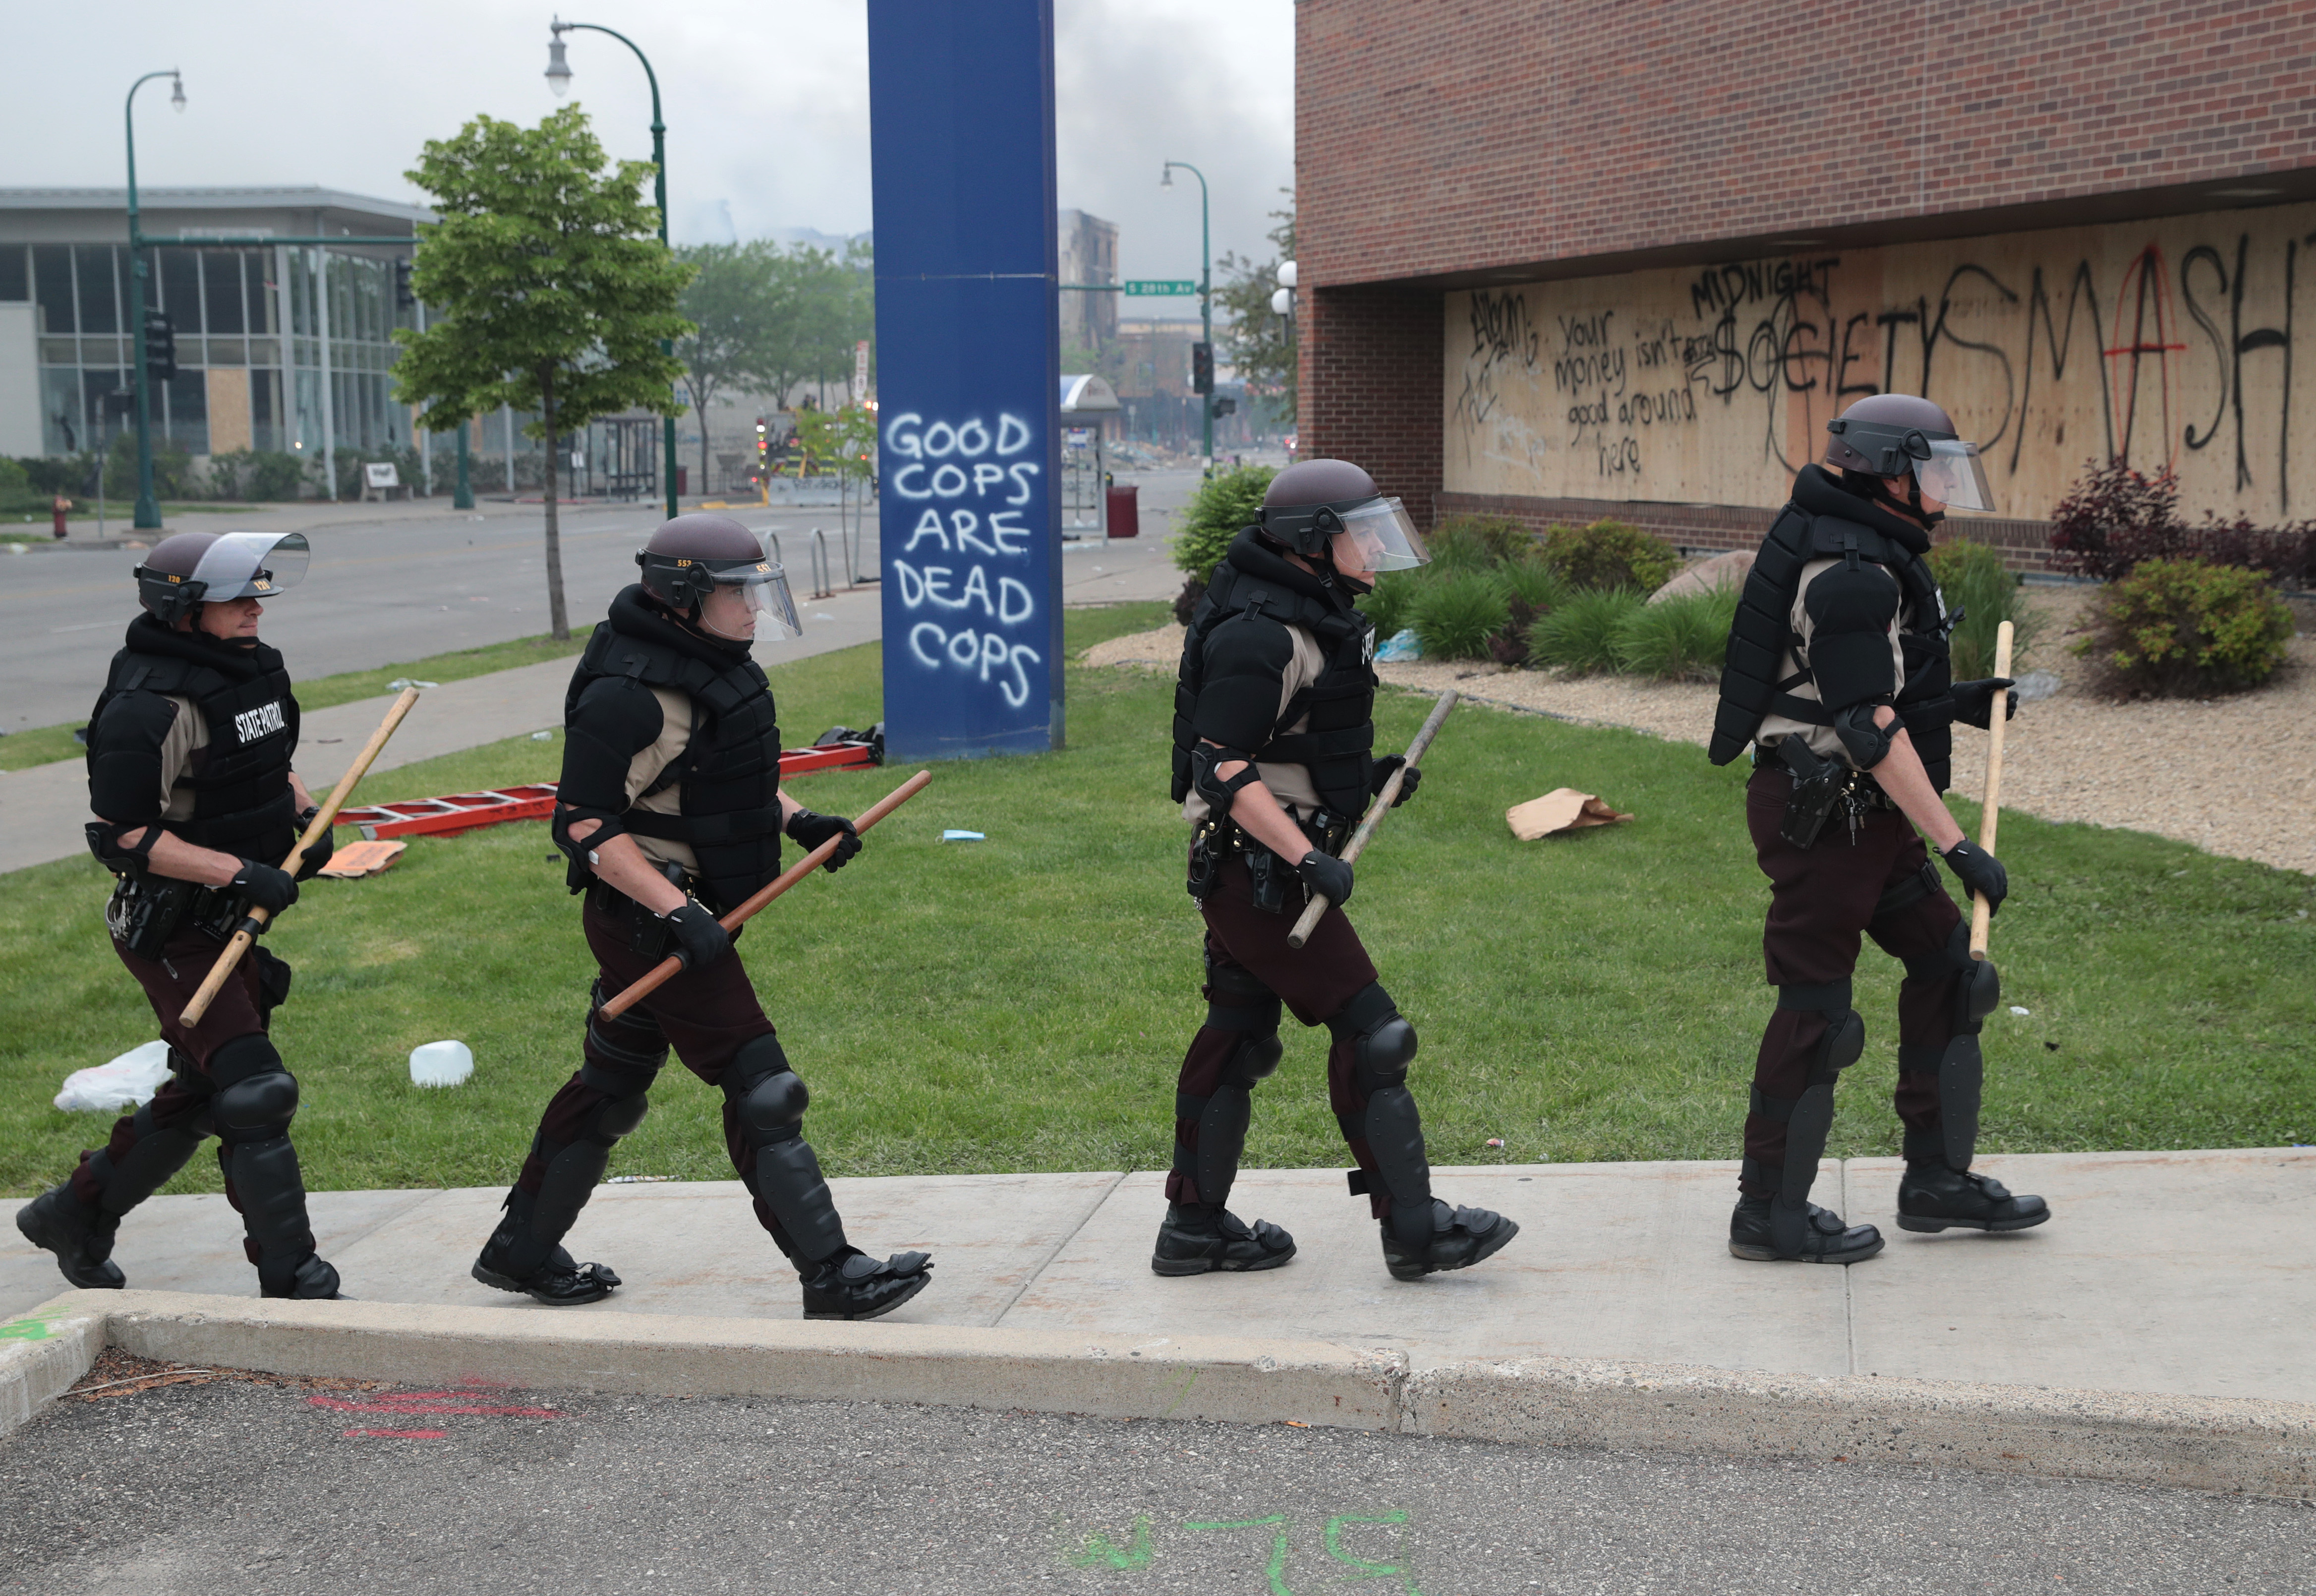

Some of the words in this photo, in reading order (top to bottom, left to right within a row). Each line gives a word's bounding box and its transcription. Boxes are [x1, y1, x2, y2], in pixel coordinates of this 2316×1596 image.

[1128, 283, 1136, 293] S
[1691, 257, 1840, 319] MIDNIGHT
[1555, 347, 1626, 397] money
[1636, 318, 1682, 368] isn't
[1568, 391, 1610, 447] good
[1619, 372, 1697, 426] around
[886, 411, 1032, 460] GOOD
[1597, 431, 1641, 476] here
[893, 462, 1040, 506] COPS
[904, 508, 1031, 556] ARE
[168, 574, 180, 583] 120
[254, 580, 271, 591] 120
[893, 558, 1034, 625] DEAD
[909, 621, 1041, 709] COPS
[234, 709, 264, 743] STATE
[258, 700, 285, 735] PATROL
